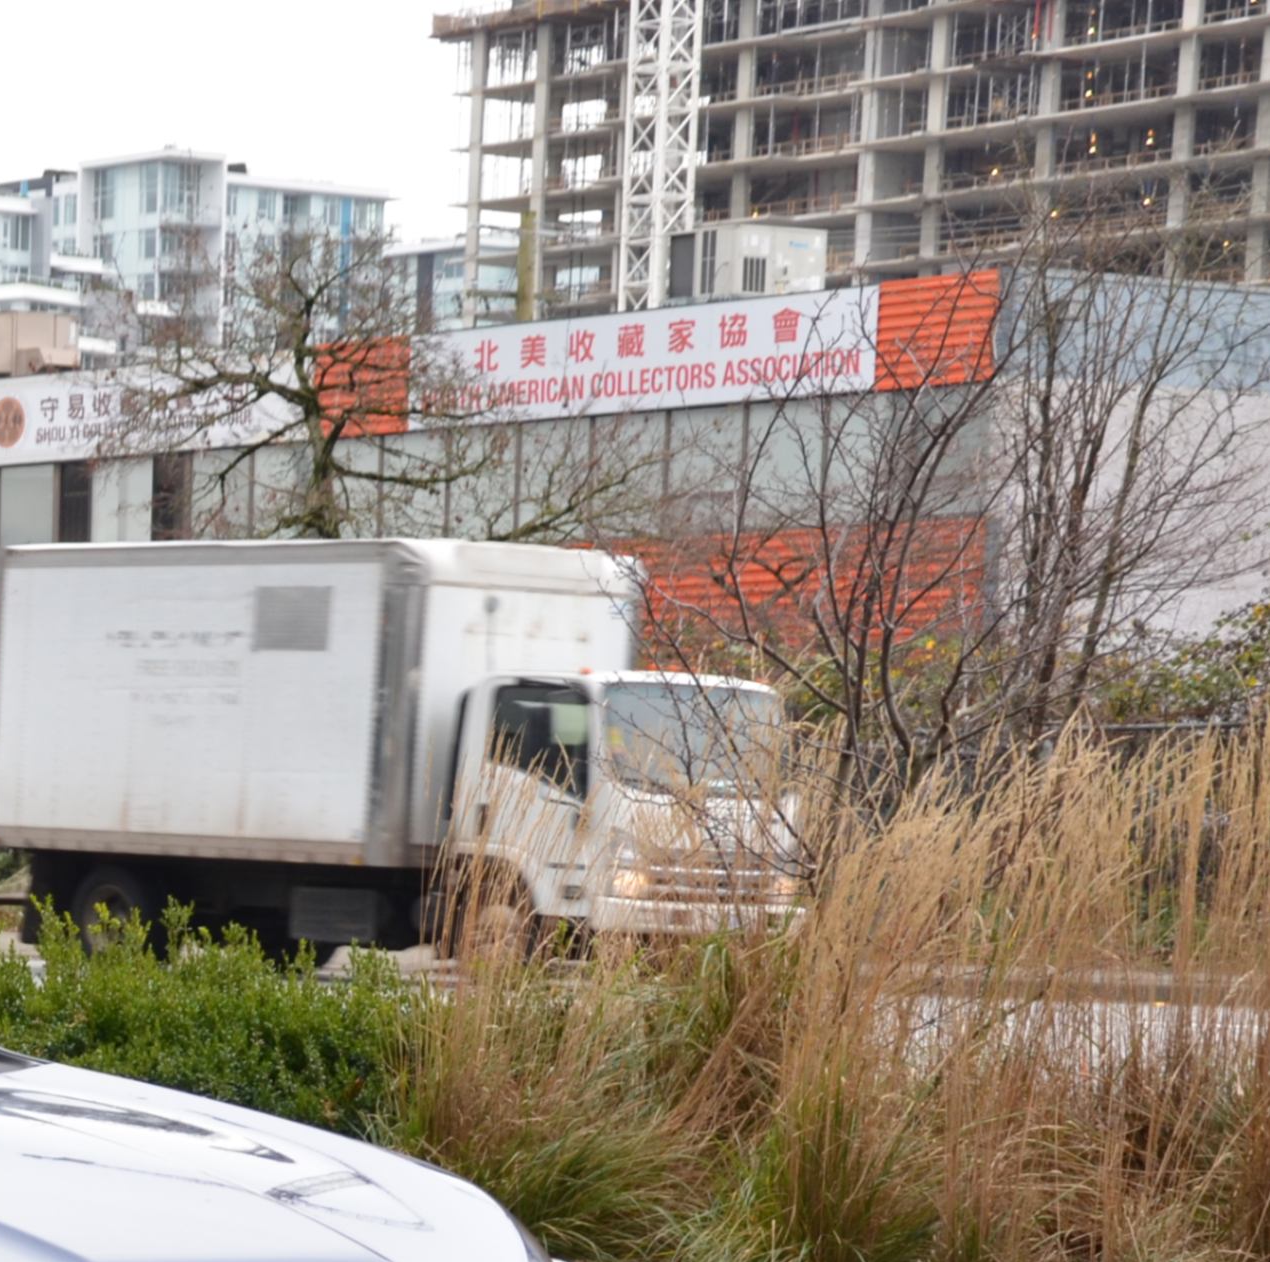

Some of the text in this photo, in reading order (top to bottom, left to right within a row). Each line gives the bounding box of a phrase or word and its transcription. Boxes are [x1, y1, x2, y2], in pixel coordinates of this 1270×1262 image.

[474, 307, 802, 373] 北美收藏家協會
[487, 373, 584, 408] AMERICAN
[591, 361, 716, 398] COLLECTORS
[722, 348, 861, 386] ASSOCIATION
[35, 426, 66, 444] SHOU
[69, 424, 80, 441] YI
